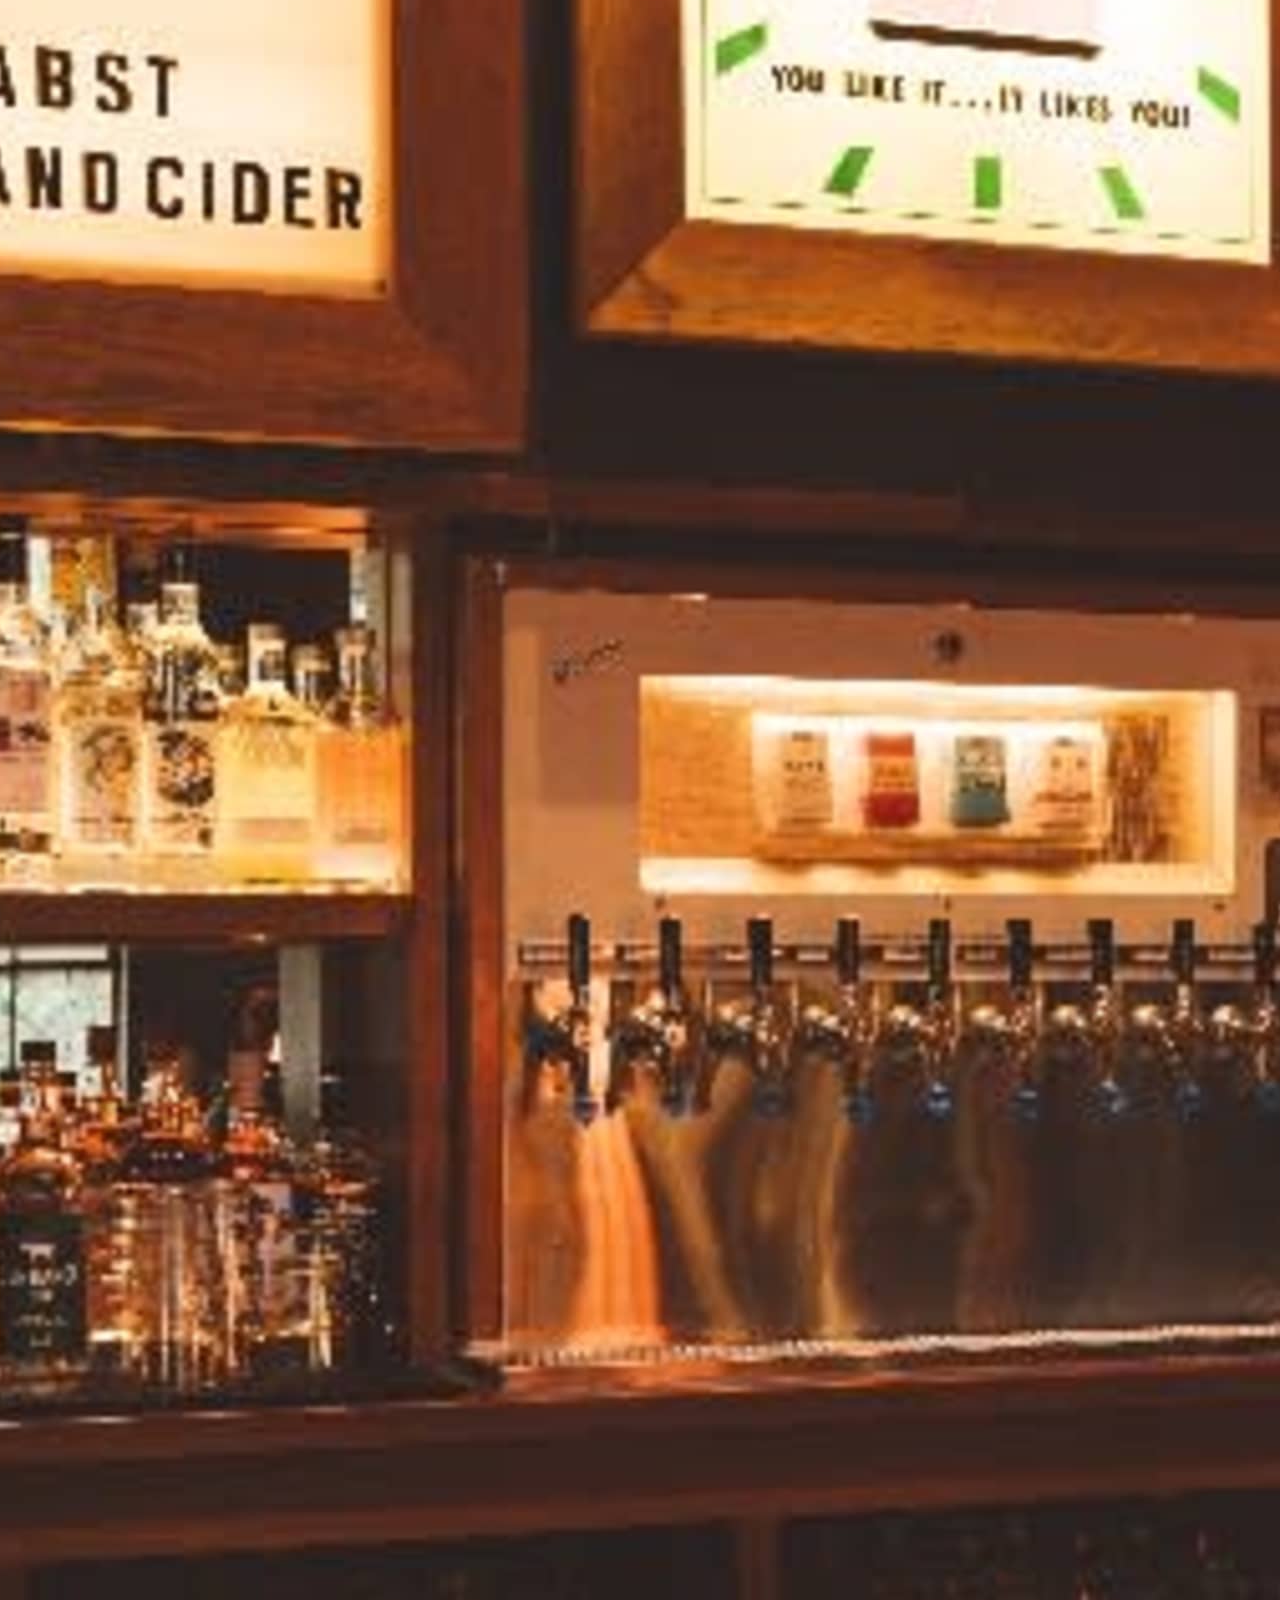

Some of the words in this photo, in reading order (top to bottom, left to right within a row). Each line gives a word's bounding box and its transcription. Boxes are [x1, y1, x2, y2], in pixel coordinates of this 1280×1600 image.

[769, 65, 825, 94] YOU
[844, 71, 905, 103] LIKE
[1040, 91, 1114, 124] LIKES
[1130, 100, 1190, 129] YOU!
